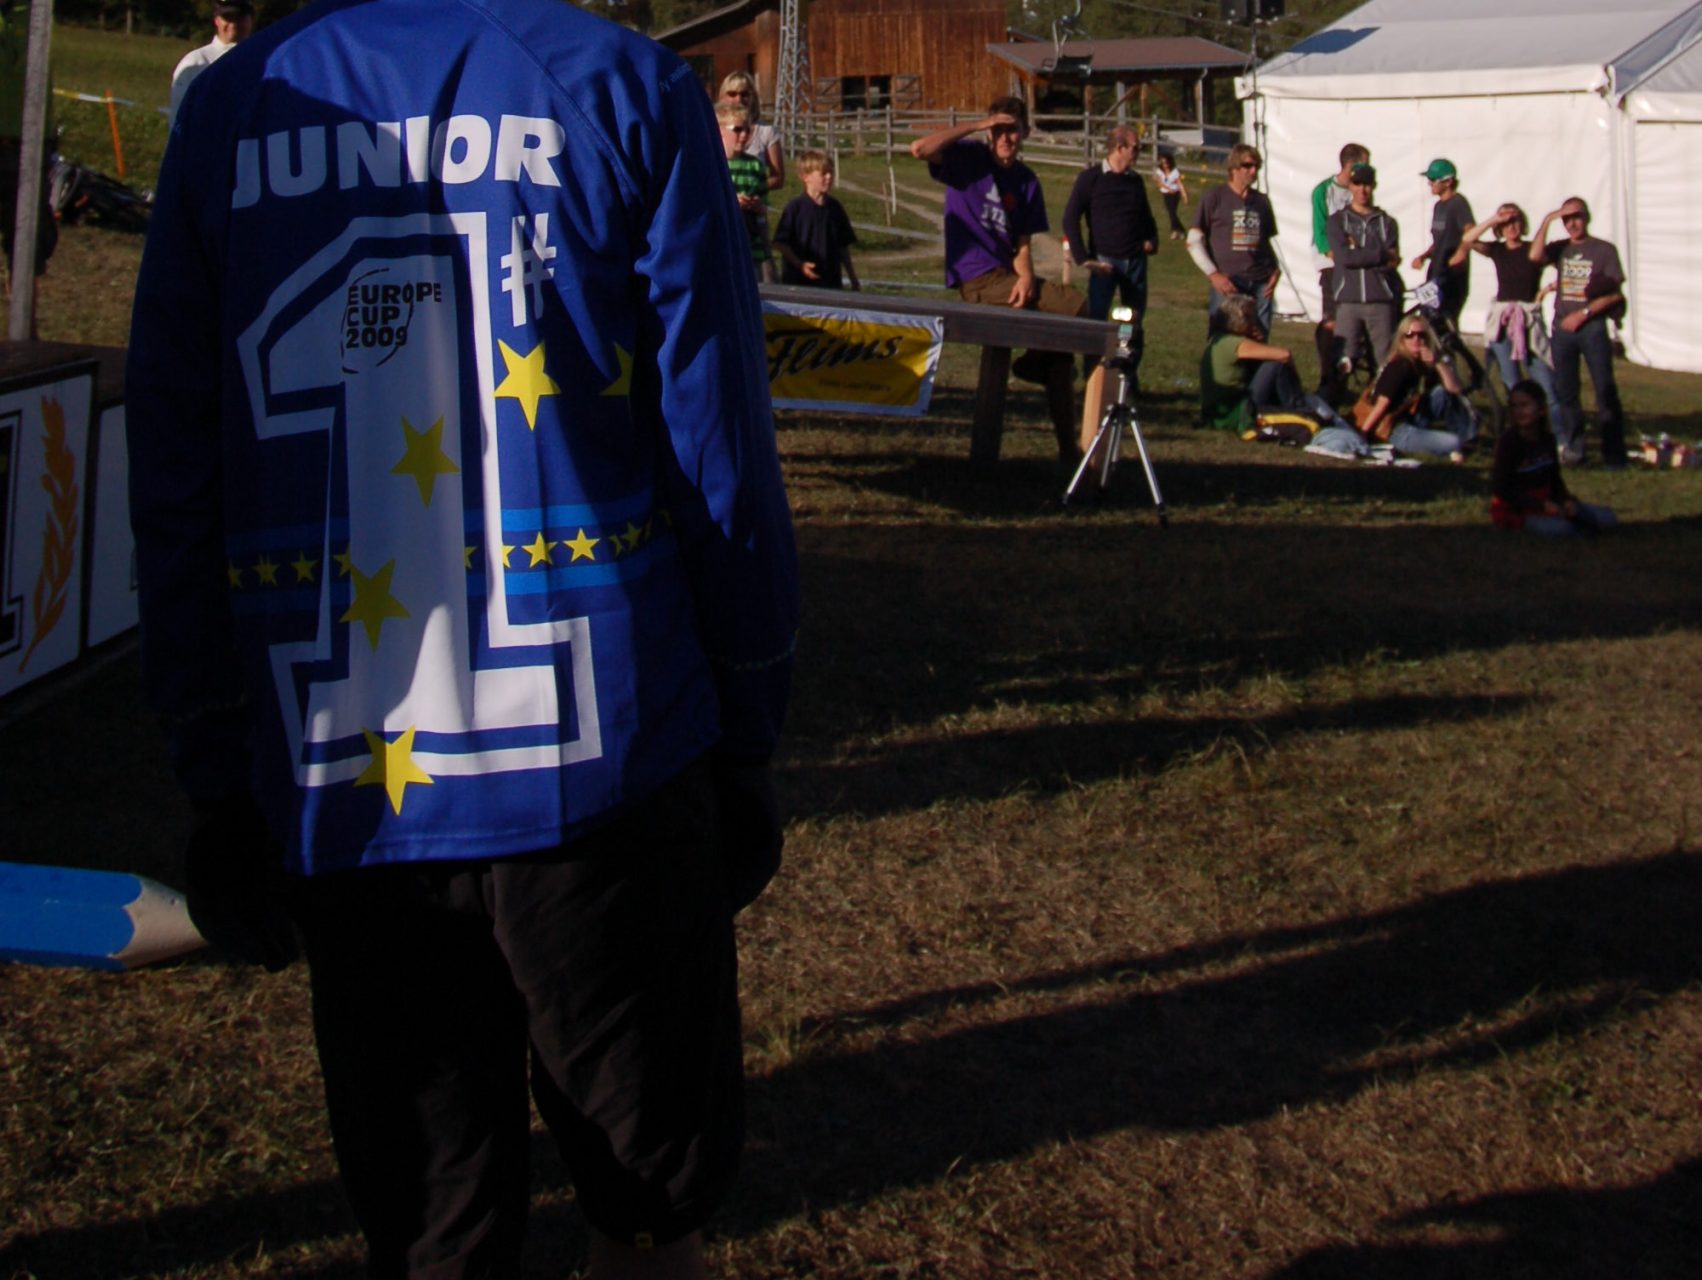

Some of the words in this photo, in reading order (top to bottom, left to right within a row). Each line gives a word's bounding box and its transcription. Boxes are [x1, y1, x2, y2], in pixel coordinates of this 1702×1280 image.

[232, 114, 566, 209] JUNIOR
[348, 281, 442, 305] EUROPE
[347, 306, 401, 327] CUP
[346, 326, 408, 349] 2009
[766, 328, 903, 382] Flims
